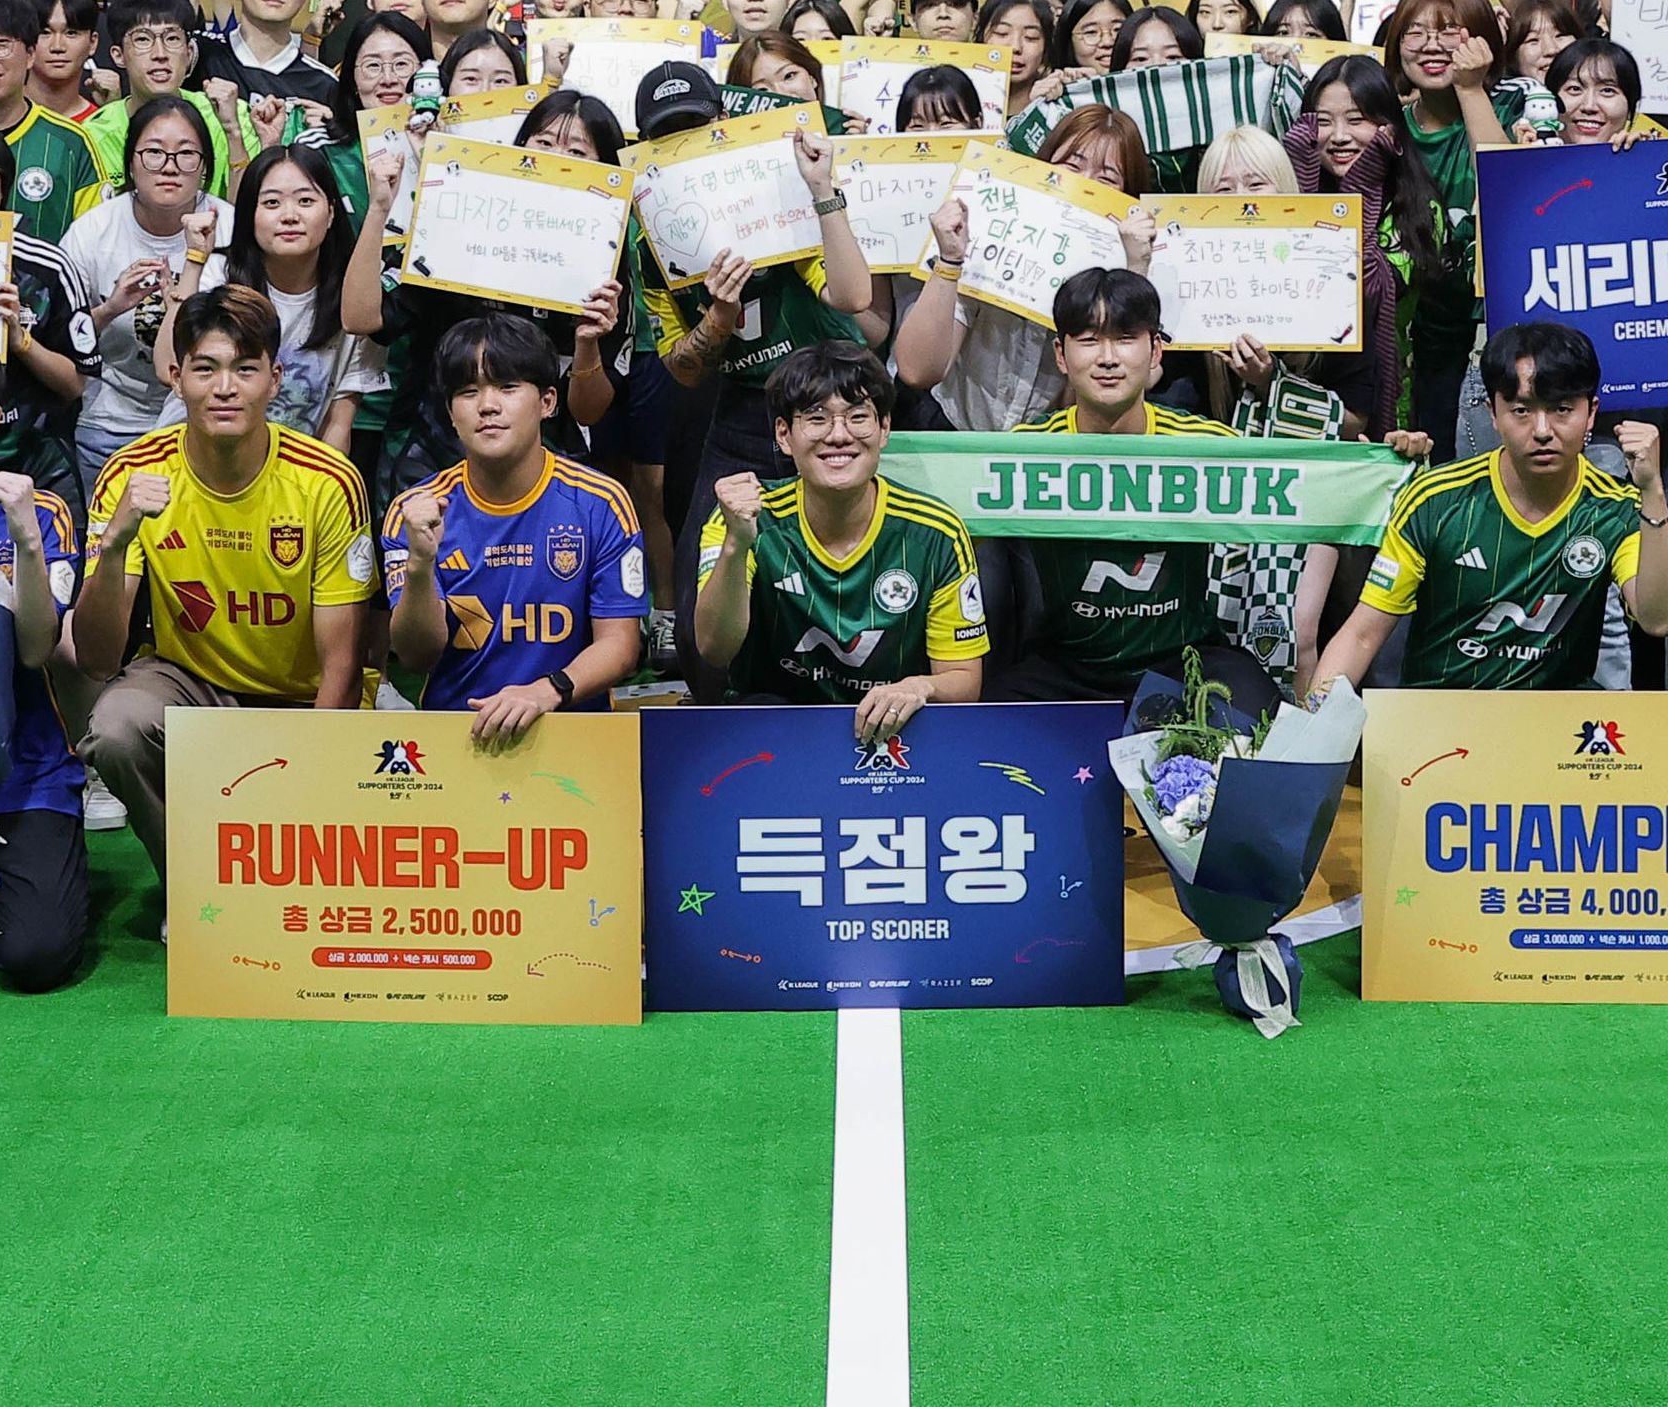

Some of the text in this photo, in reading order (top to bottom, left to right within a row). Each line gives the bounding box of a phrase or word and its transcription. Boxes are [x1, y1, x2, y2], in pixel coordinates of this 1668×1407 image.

[733, 339, 793, 371] HYUNDAI
[976, 460, 1302, 518] JEONBUK
[227, 590, 297, 627] HD
[501, 602, 574, 644] HD
[1104, 598, 1180, 620] HYUNDAI
[216, 822, 589, 891] RUNNER-UP
[735, 813, 1036, 908] 득점왕
[1478, 888, 1506, 916] 총
[1516, 888, 1571, 916] 상금
[282, 905, 522, 937] 총 상금 2,500,000
[826, 918, 951, 942] TOP SCORER
